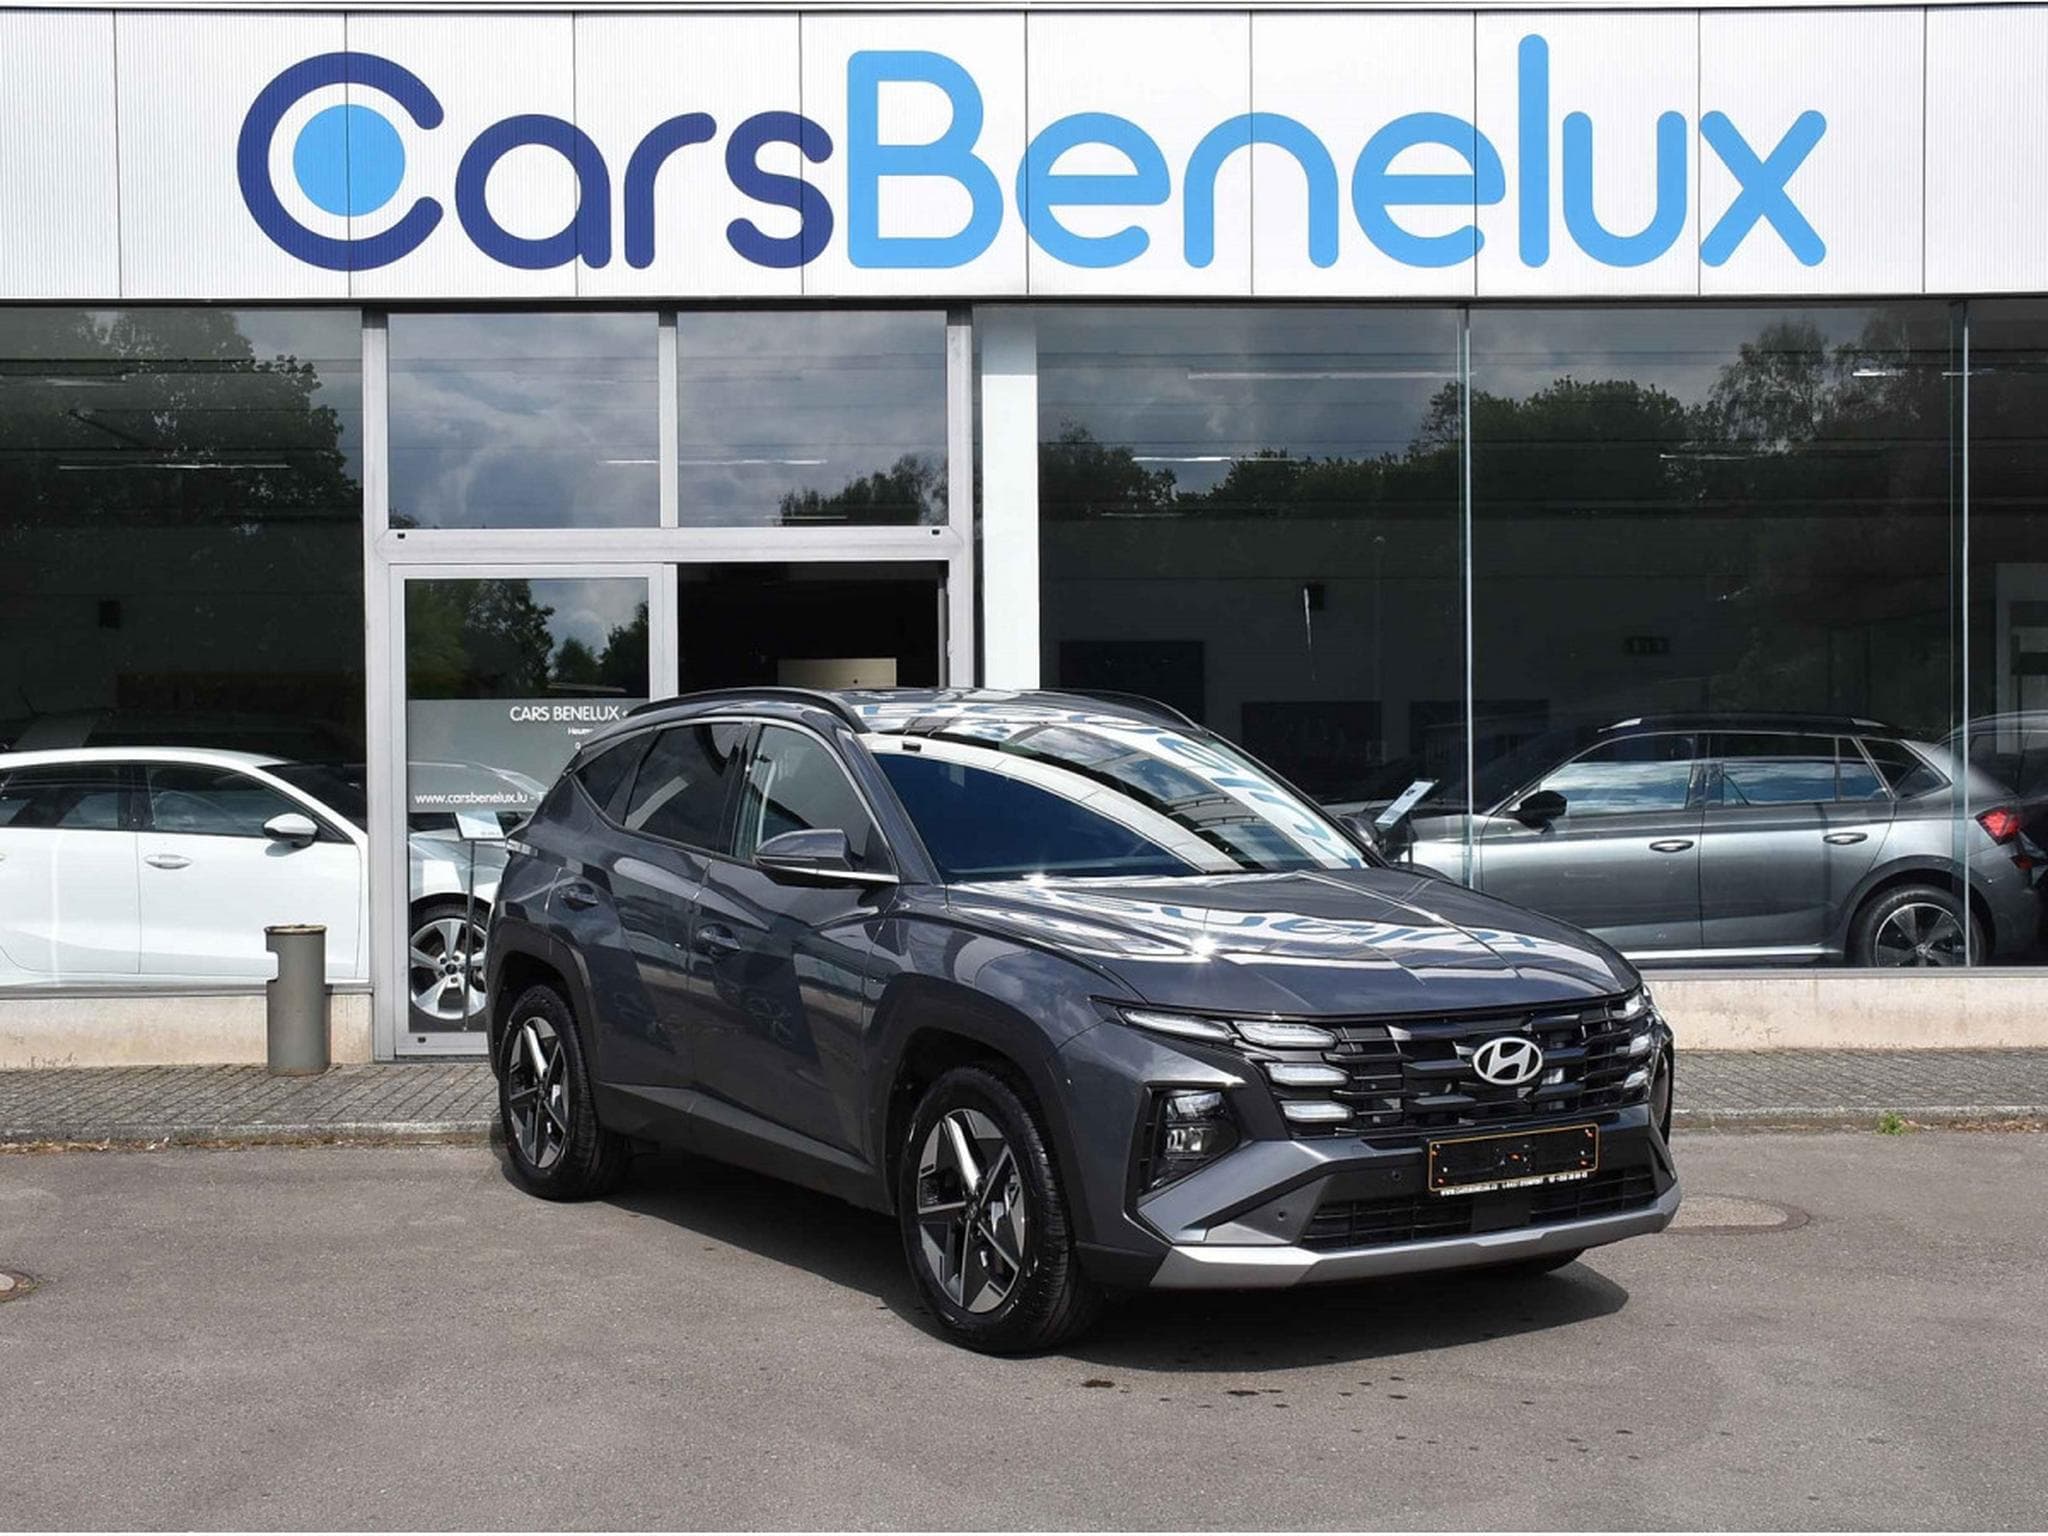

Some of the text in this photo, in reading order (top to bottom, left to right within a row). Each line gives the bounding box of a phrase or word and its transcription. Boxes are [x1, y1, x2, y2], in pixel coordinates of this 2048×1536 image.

[509, 705, 620, 722] CARS BENELUX
[414, 791, 528, 804] www.carsbenelux.lu
